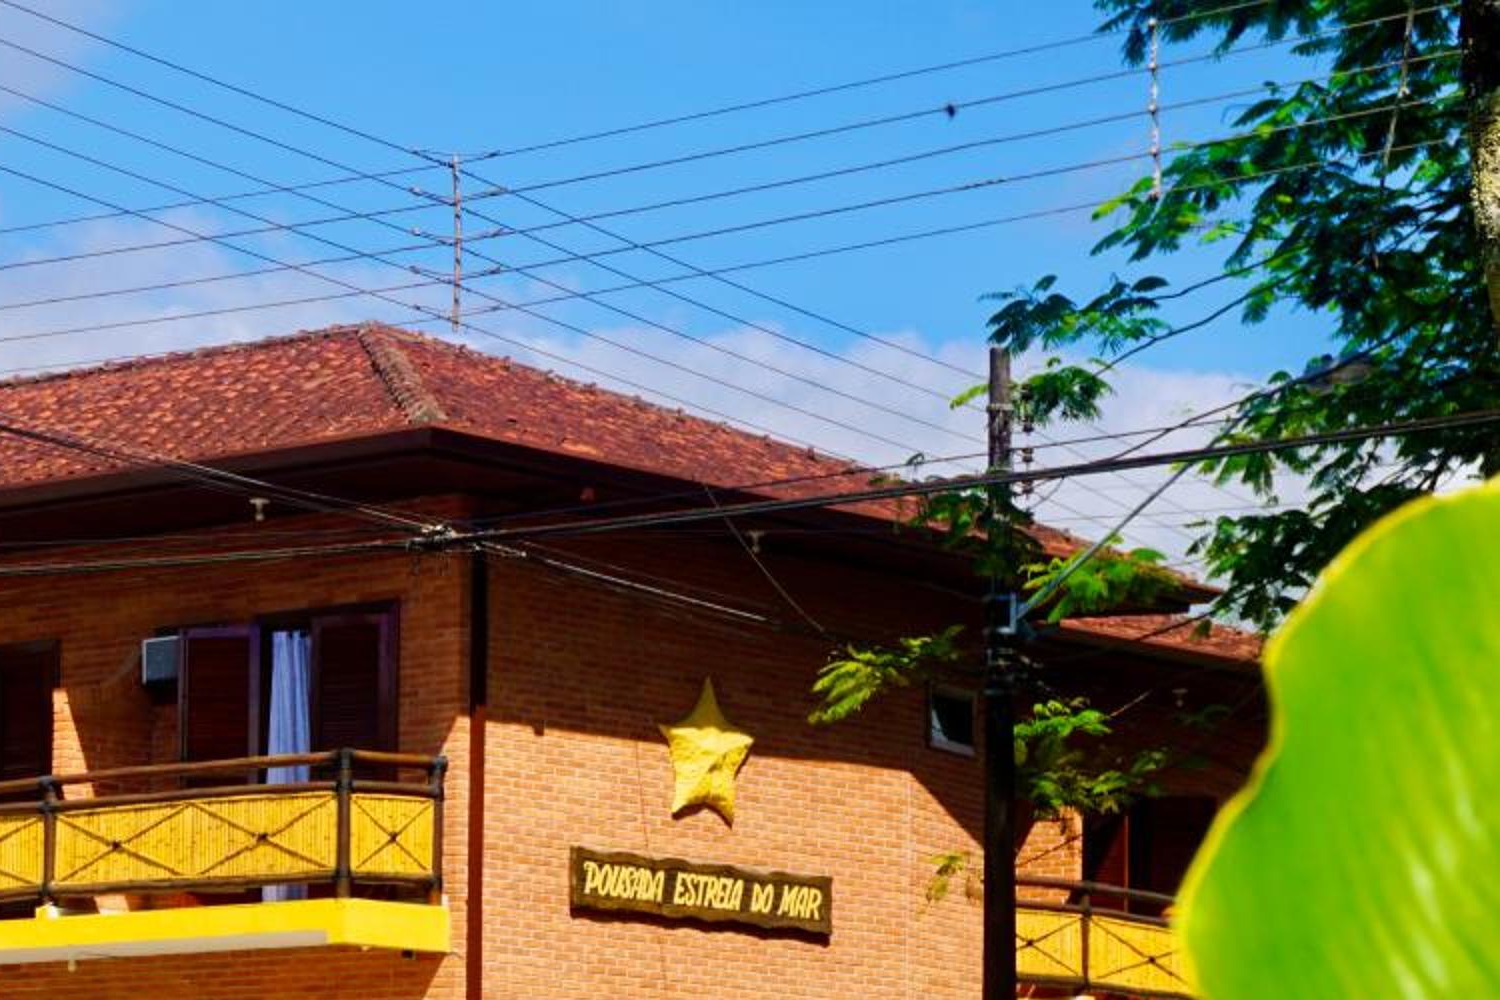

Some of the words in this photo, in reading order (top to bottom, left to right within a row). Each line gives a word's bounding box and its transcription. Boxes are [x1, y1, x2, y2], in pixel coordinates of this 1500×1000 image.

[583, 860, 665, 902] POUSADA
[673, 871, 745, 911] ESTRELA
[750, 883, 775, 914] DO
[776, 885, 823, 920] MAR
